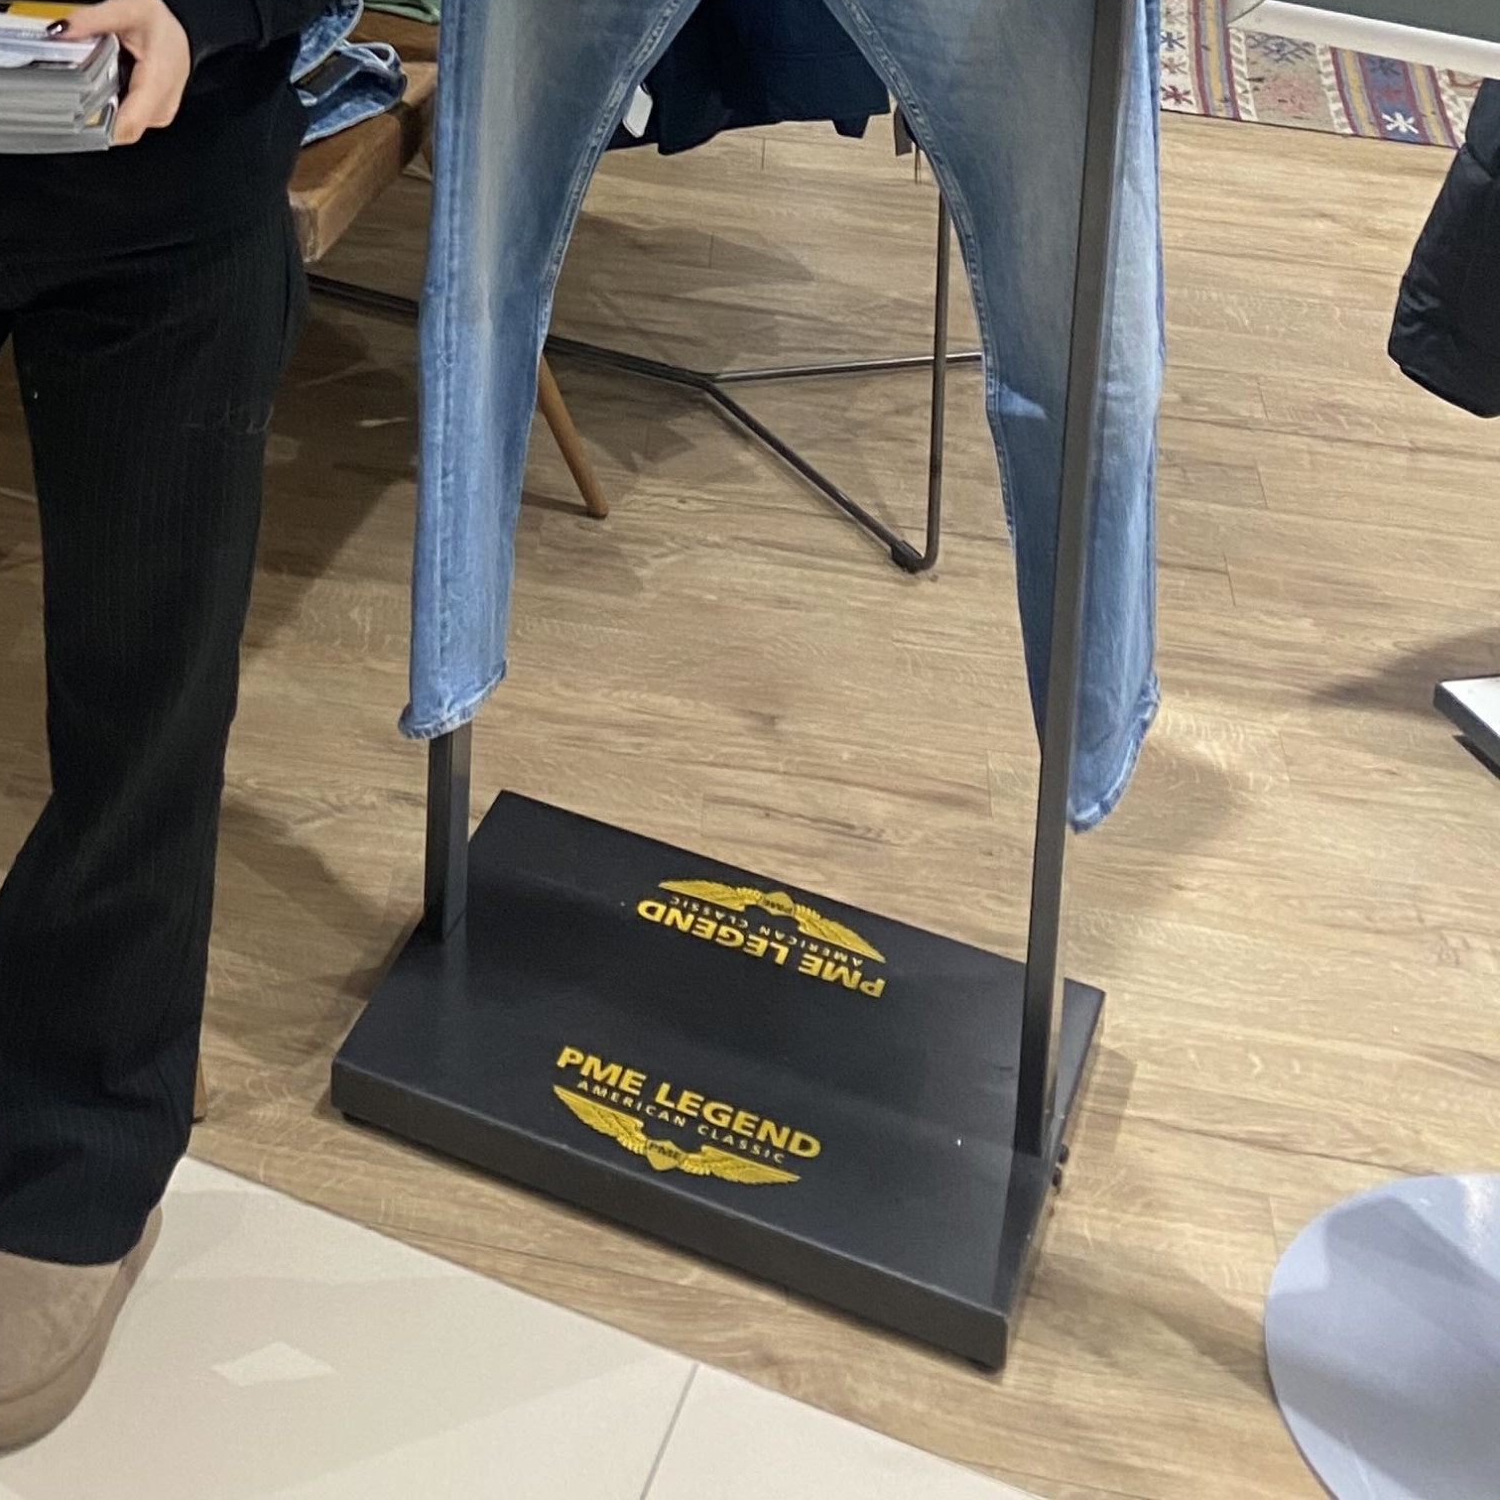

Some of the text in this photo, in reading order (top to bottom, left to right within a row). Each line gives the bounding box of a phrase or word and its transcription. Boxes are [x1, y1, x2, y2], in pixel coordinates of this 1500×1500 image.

[636, 899, 887, 998] PME LEGEND
[669, 895, 864, 968] AMERICAN CLASSIC
[555, 1045, 823, 1160] PME LEGEND
[576, 1079, 786, 1165] AMERICAN CLASSIC
